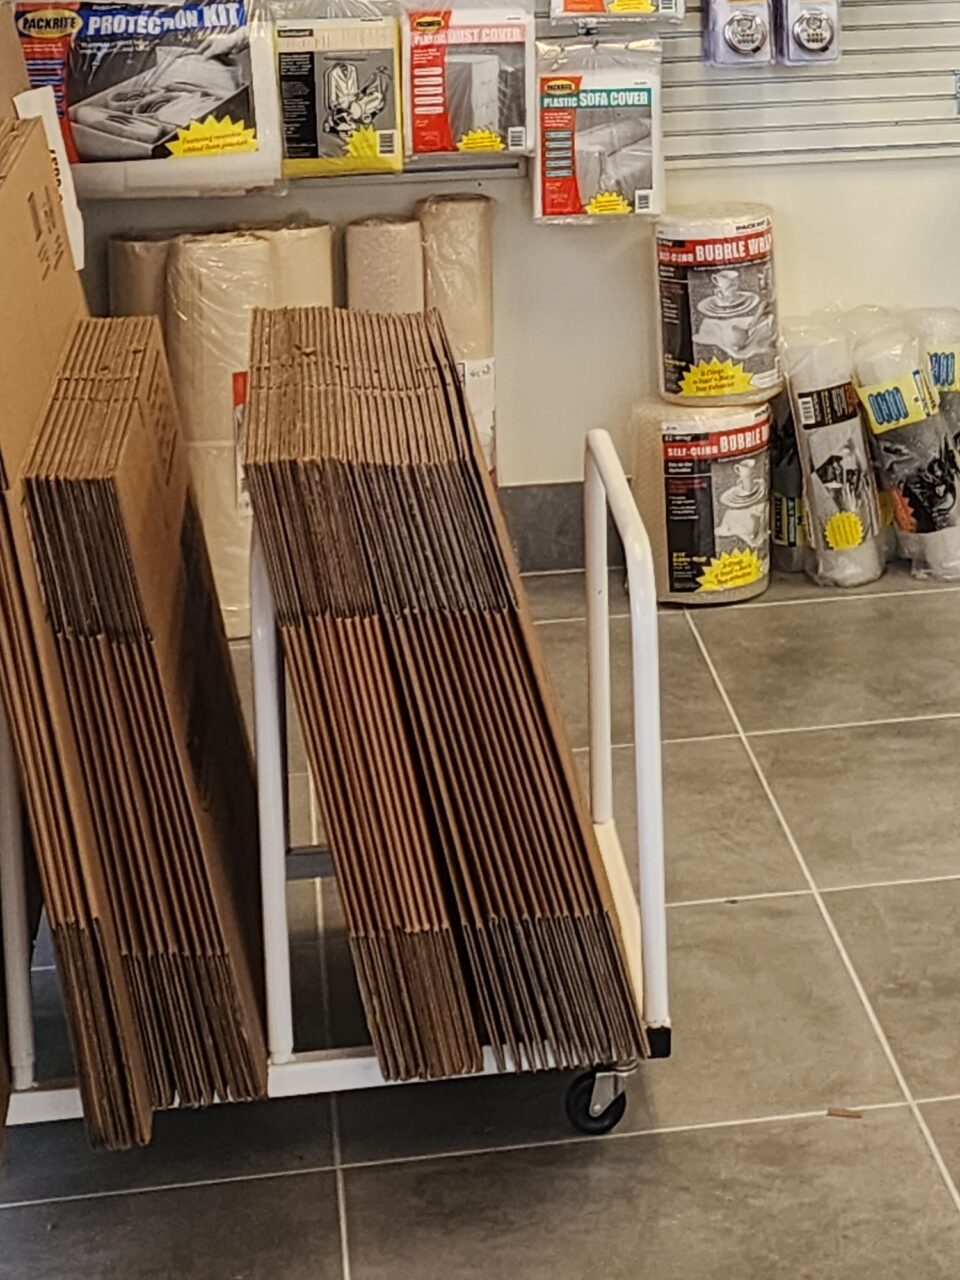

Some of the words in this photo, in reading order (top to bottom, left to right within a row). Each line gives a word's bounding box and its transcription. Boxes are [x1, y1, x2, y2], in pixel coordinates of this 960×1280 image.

[23, 17, 76, 30] PACKRITE
[204, 3, 240, 28] KIT
[451, 30, 480, 42] DUST
[482, 28, 521, 41] COVER
[543, 97, 578, 108] PLASTIC
[579, 92, 608, 107] SOFA
[610, 91, 648, 106] COVER
[696, 241, 746, 261] BUBBLE
[720, 428, 761, 453] BUBBLE
